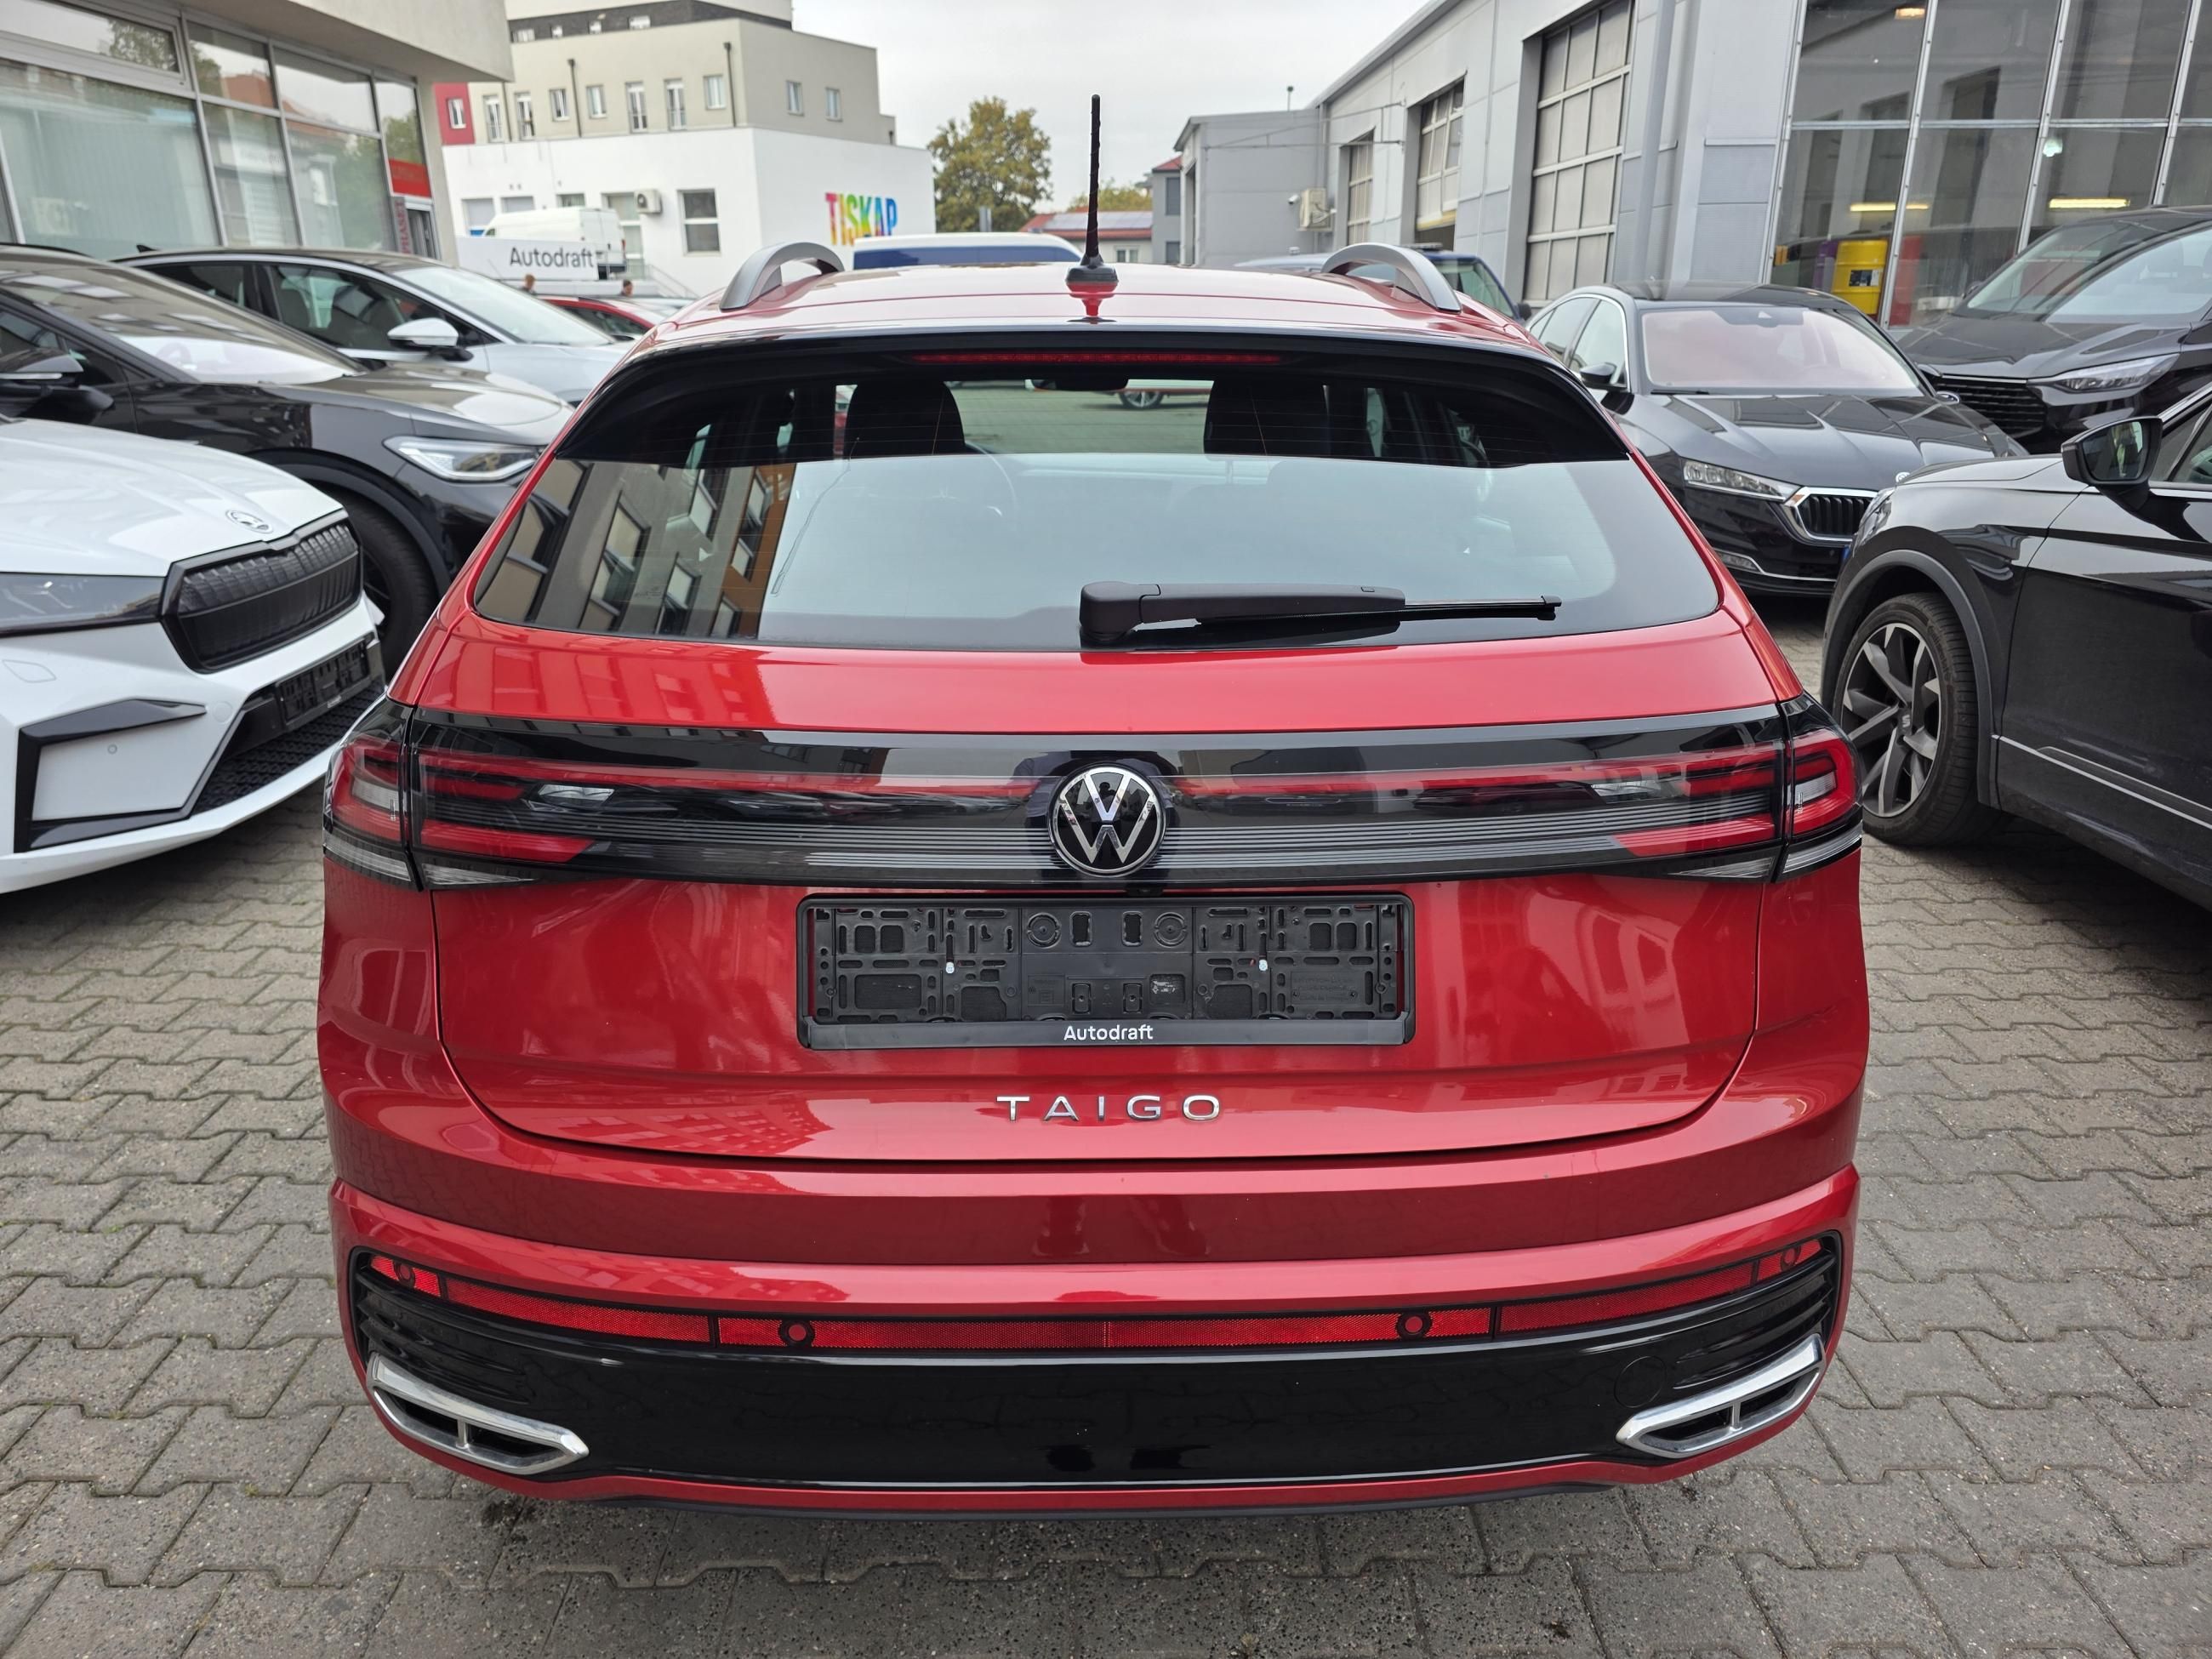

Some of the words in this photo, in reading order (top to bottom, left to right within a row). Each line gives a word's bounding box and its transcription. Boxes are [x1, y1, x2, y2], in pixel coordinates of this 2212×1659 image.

[510, 247, 596, 268] Autodraft
[1063, 1023, 1154, 1040] Autodraft
[996, 1095, 1221, 1121] TAIGO
